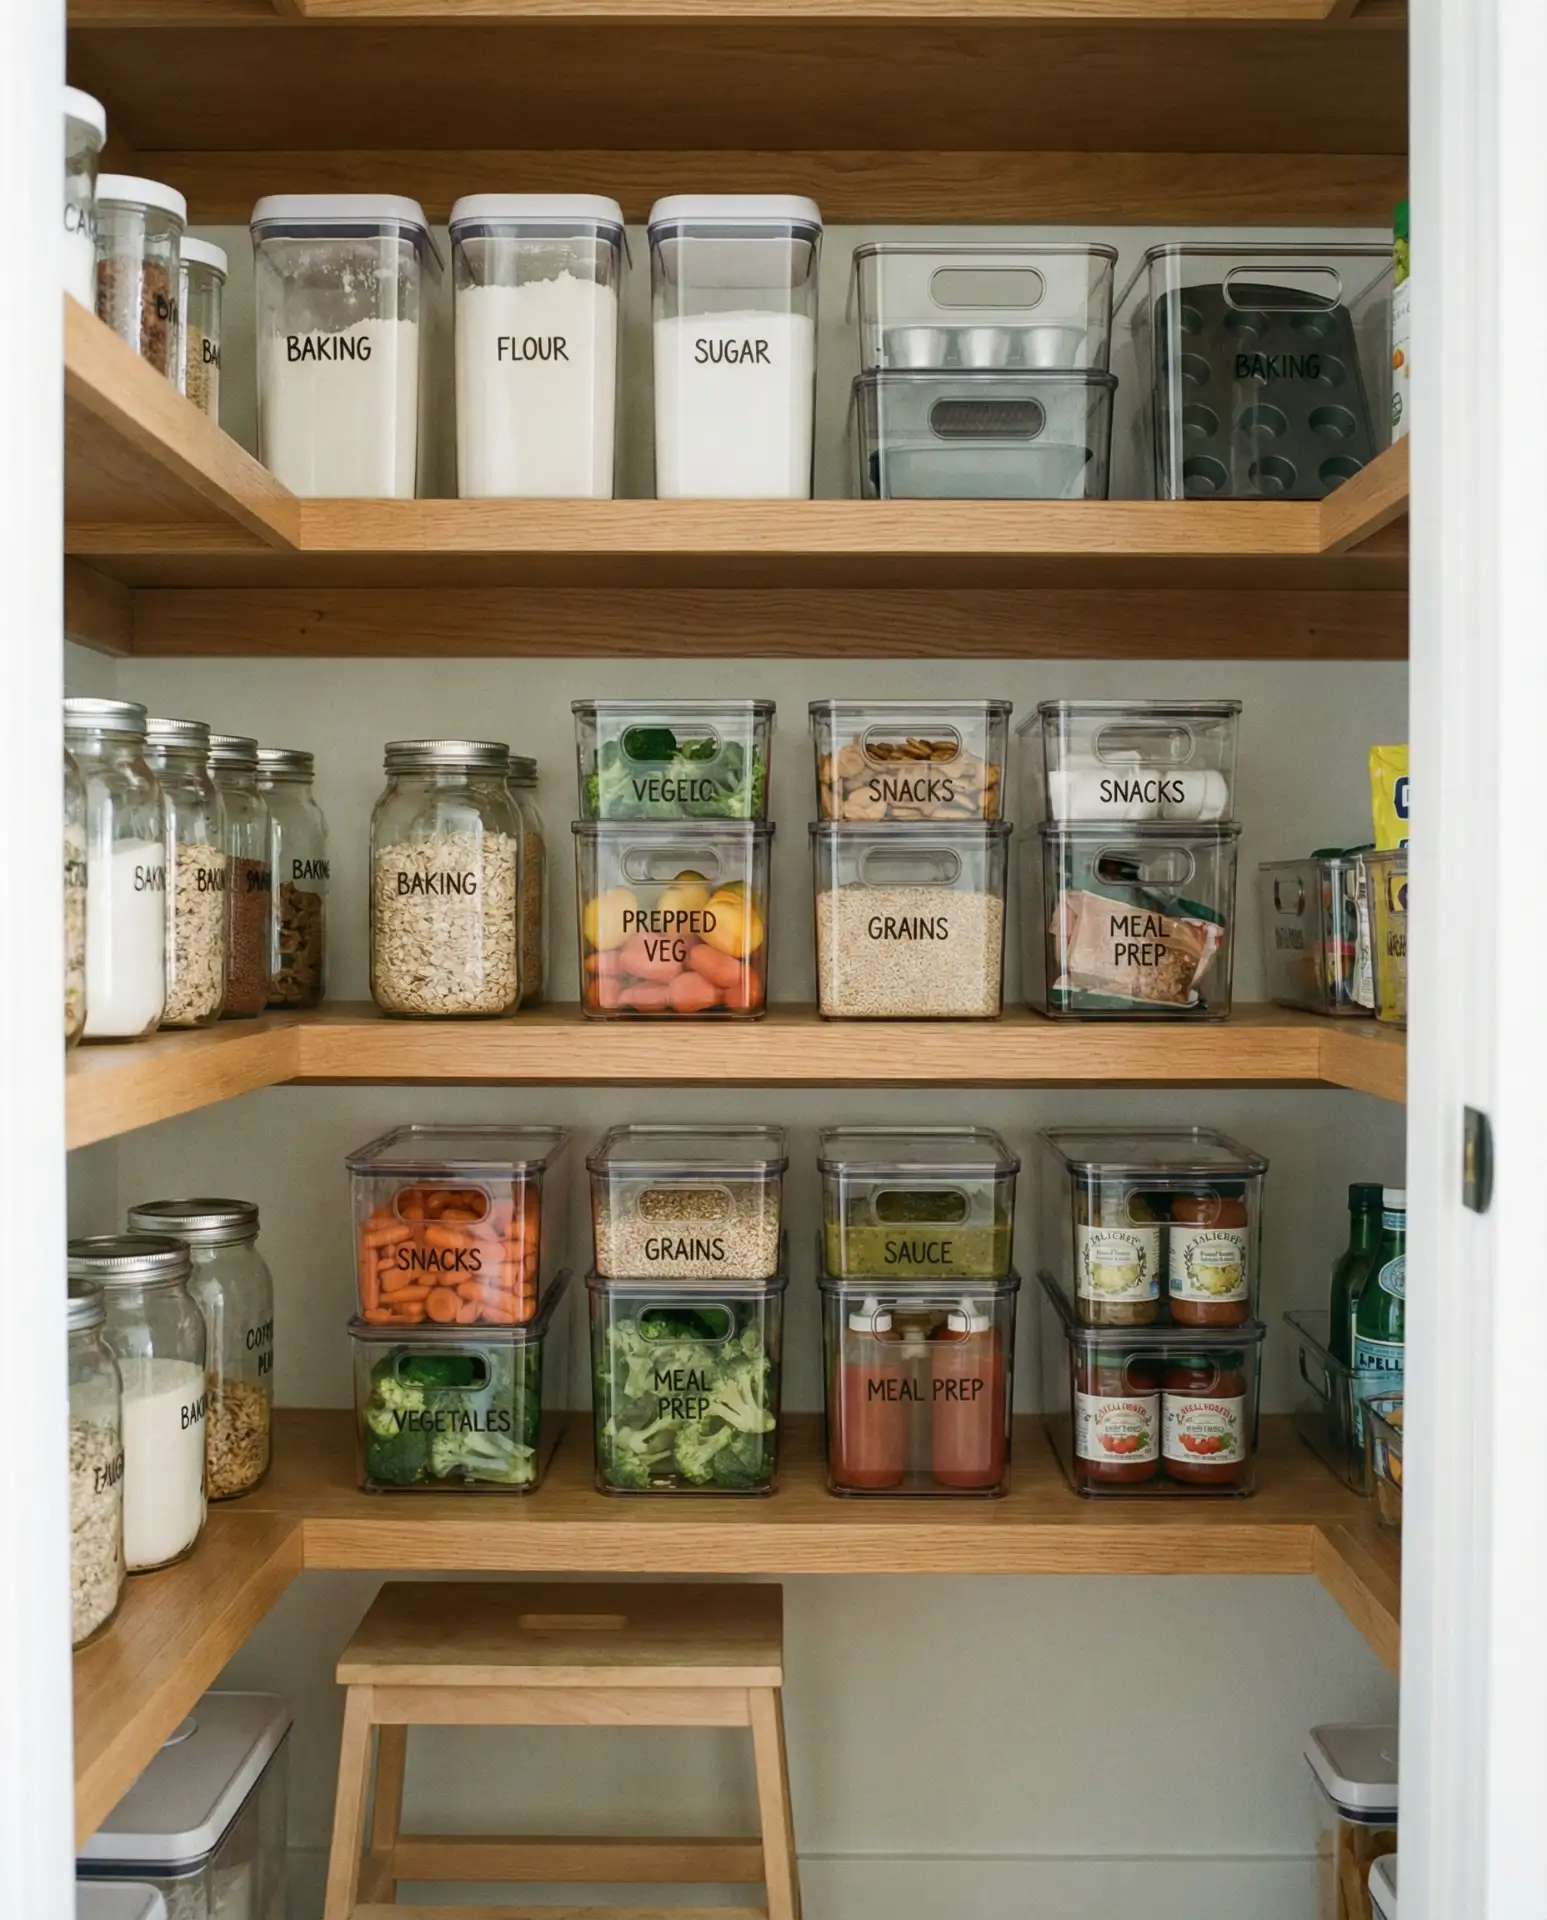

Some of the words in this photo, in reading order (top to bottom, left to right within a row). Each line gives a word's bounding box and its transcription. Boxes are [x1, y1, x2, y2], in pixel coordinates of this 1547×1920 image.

[287, 335, 373, 362] BAKING
[497, 336, 570, 361] FLOUR
[694, 338, 771, 364] SUGAR
[1234, 353, 1321, 380] BAKING
[868, 778, 955, 803] SNACKS
[1099, 779, 1186, 804] SNACKS
[397, 871, 477, 896] BAKING
[622, 909, 717, 934] PREPPED
[868, 916, 949, 941] GRAINS
[1110, 914, 1170, 938] MEAL
[643, 938, 687, 963] VEG
[1114, 942, 1167, 966] PREP
[397, 1247, 482, 1272] SNACKS
[644, 1237, 726, 1262] GRAINS
[884, 1240, 954, 1265] SAUCE
[653, 1368, 713, 1393] MEAL
[867, 1378, 925, 1402] MEAL
[932, 1377, 984, 1402] PREP
[393, 1408, 511, 1434] VEGETALES
[657, 1397, 711, 1421] PREP
